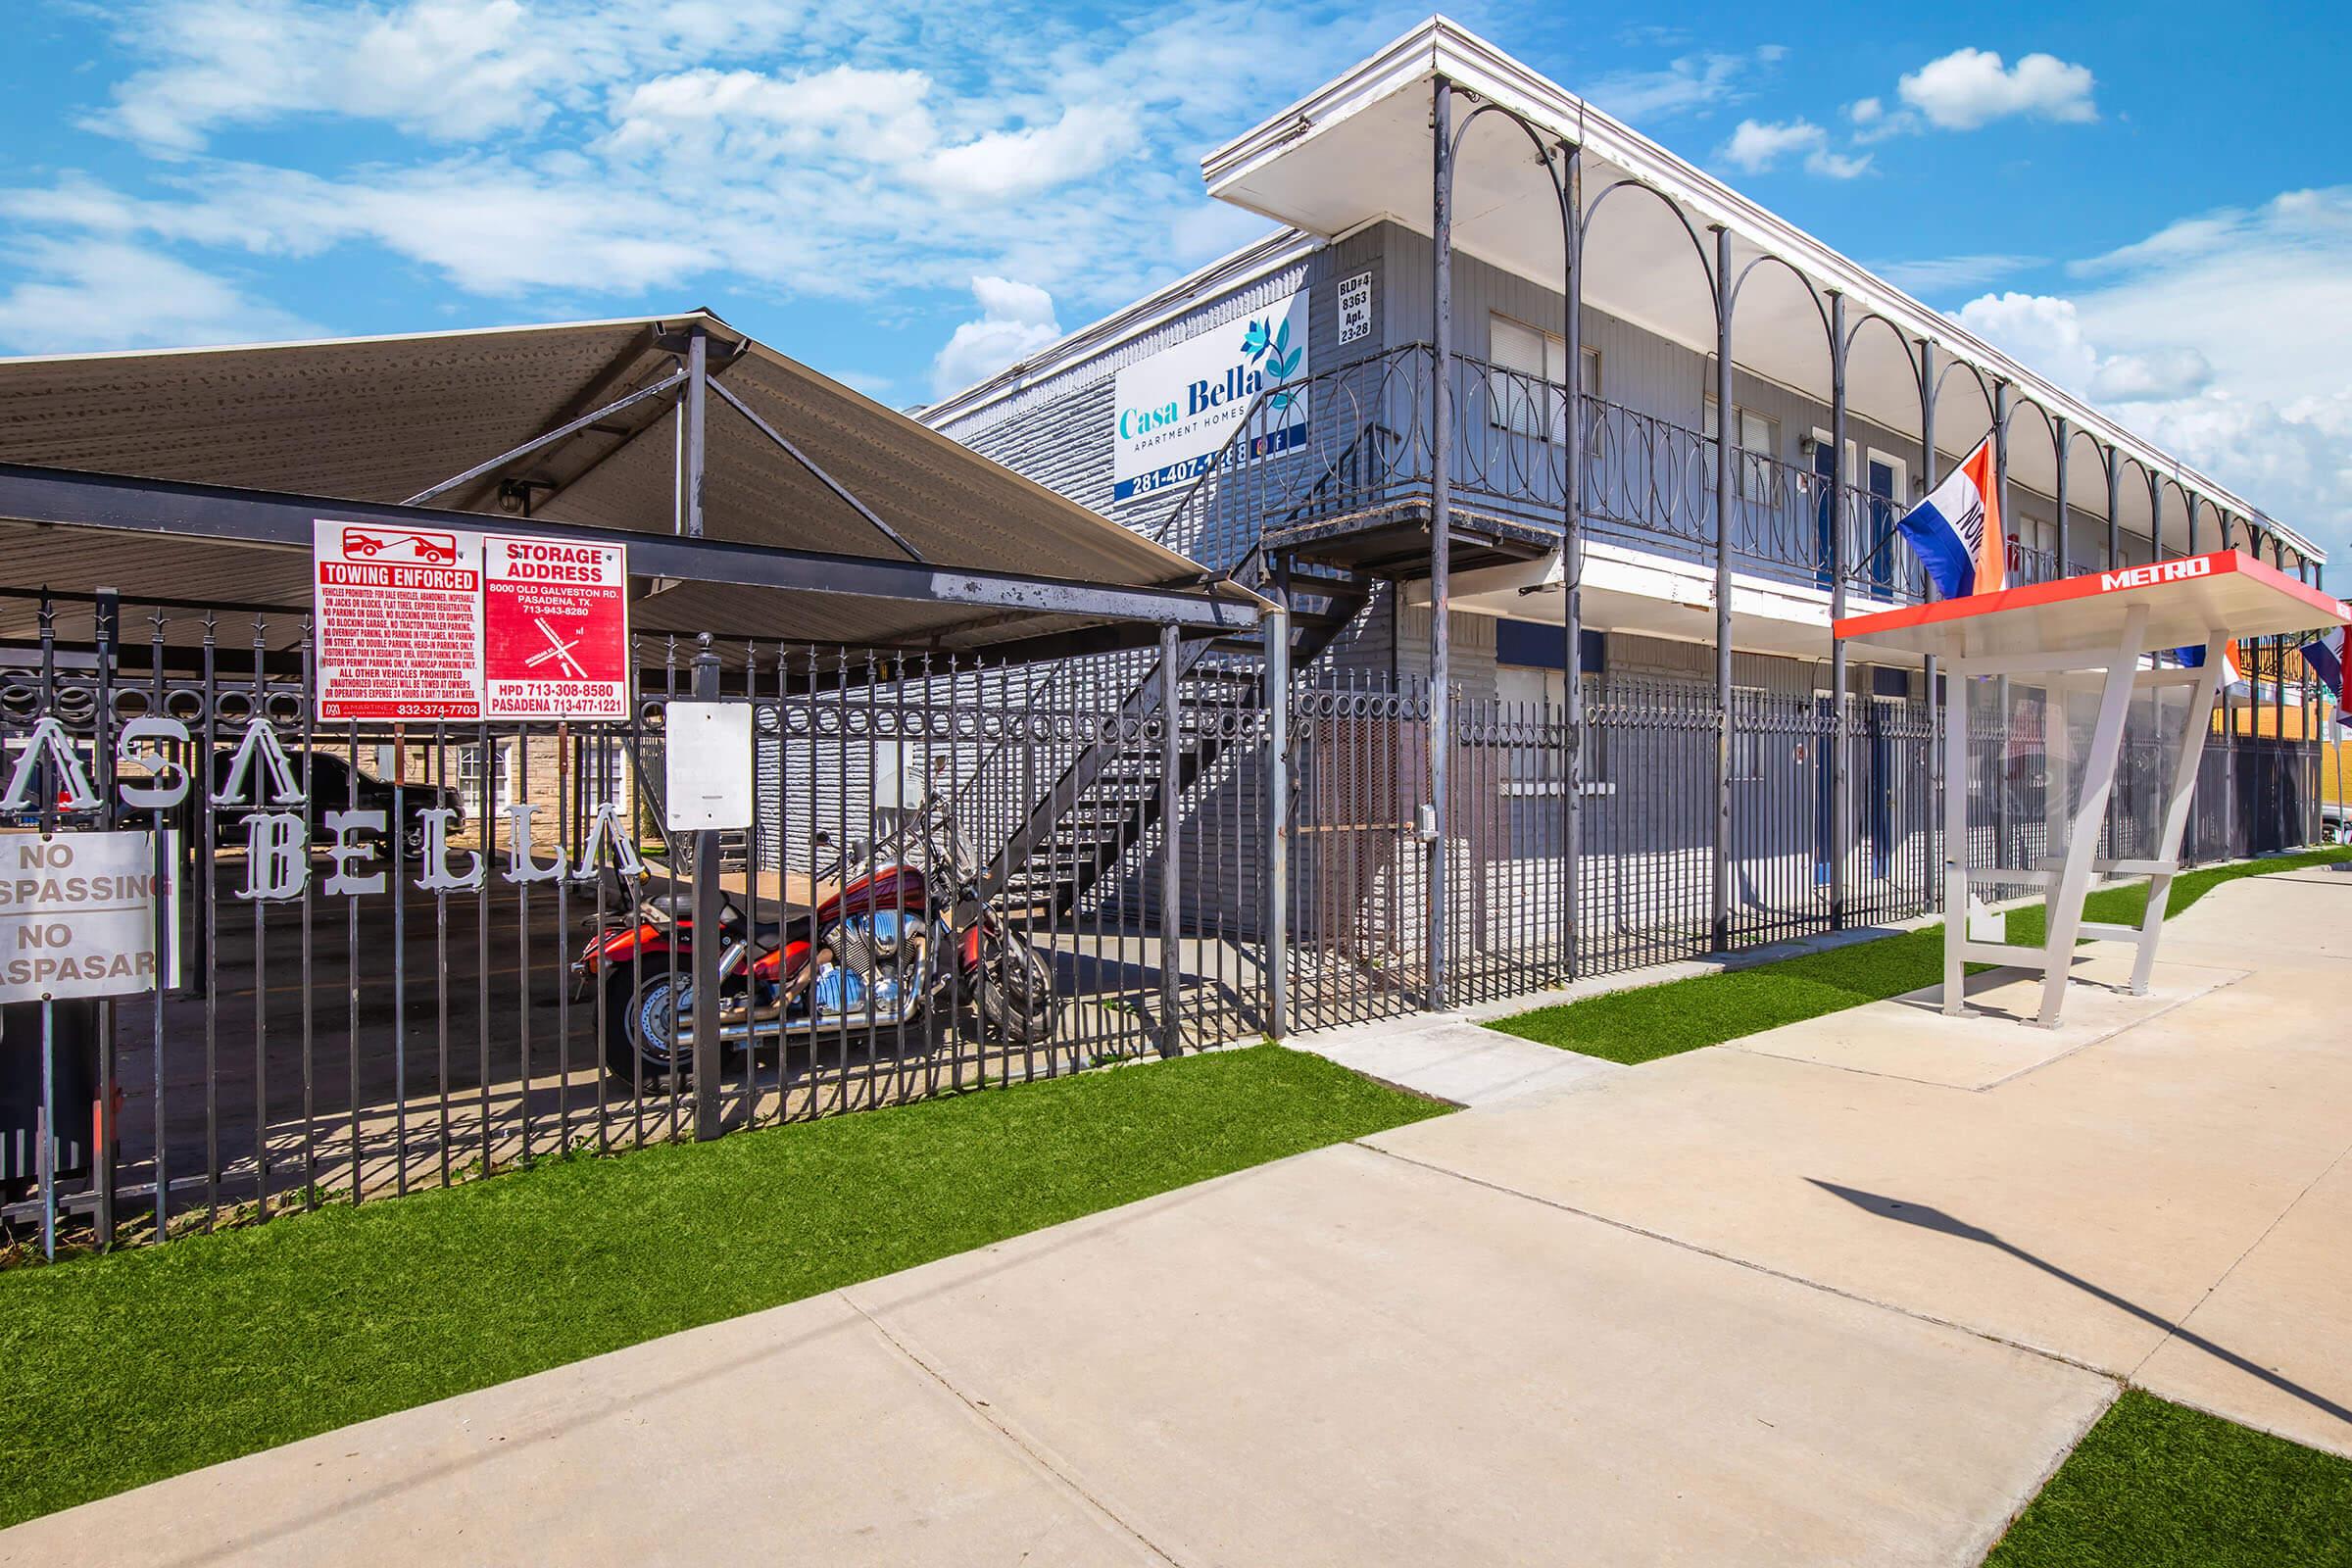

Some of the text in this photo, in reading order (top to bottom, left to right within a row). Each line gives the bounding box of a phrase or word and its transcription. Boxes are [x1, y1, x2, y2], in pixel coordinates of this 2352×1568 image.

[1343, 291, 1367, 311] 8363
[1346, 310, 1364, 326] Apt.
[1341, 321, 1368, 343] 23-28
[1119, 365, 1263, 440] Casa Bella
[1133, 406, 1245, 453] APARTMENT HOMES
[506, 544, 603, 564] STORAGE
[325, 564, 472, 590] TOWING ENFORCED
[506, 563, 602, 582] ADDRESS
[2101, 557, 2211, 592] METRO
[541, 587, 601, 598] GALVESTON
[517, 596, 575, 606] PASADENA,
[323, 608, 331, 616] NO
[332, 609, 356, 617] PARKING
[421, 612, 437, 620] DRIVE
[523, 606, 588, 615] 713-943-8280
[337, 618, 365, 627] BLOCKING
[425, 621, 446, 630] TRAILER
[332, 628, 359, 637] OVERNIGHT
[456, 632, 475, 641] PARKING
[367, 639, 387, 648] DOUBLE
[347, 659, 367, 667] PERMIT
[368, 659, 392, 667] PARKING
[339, 668, 463, 679] ALL OTHER VEHICLES PROHIBITED
[330, 679, 371, 688] UNAUTHORIZED
[372, 679, 398, 688] VEHICLES
[325, 689, 333, 698] OR
[368, 689, 392, 698] EXPENSE
[499, 685, 522, 696] HPD
[398, 705, 477, 715] 832-374-7703
[492, 699, 550, 711] PASADENA
[20, 844, 74, 870] NO
[235, 802, 644, 900] BELLA
[18, 923, 73, 949] NO
[0, 951, 155, 986] SPASAR
